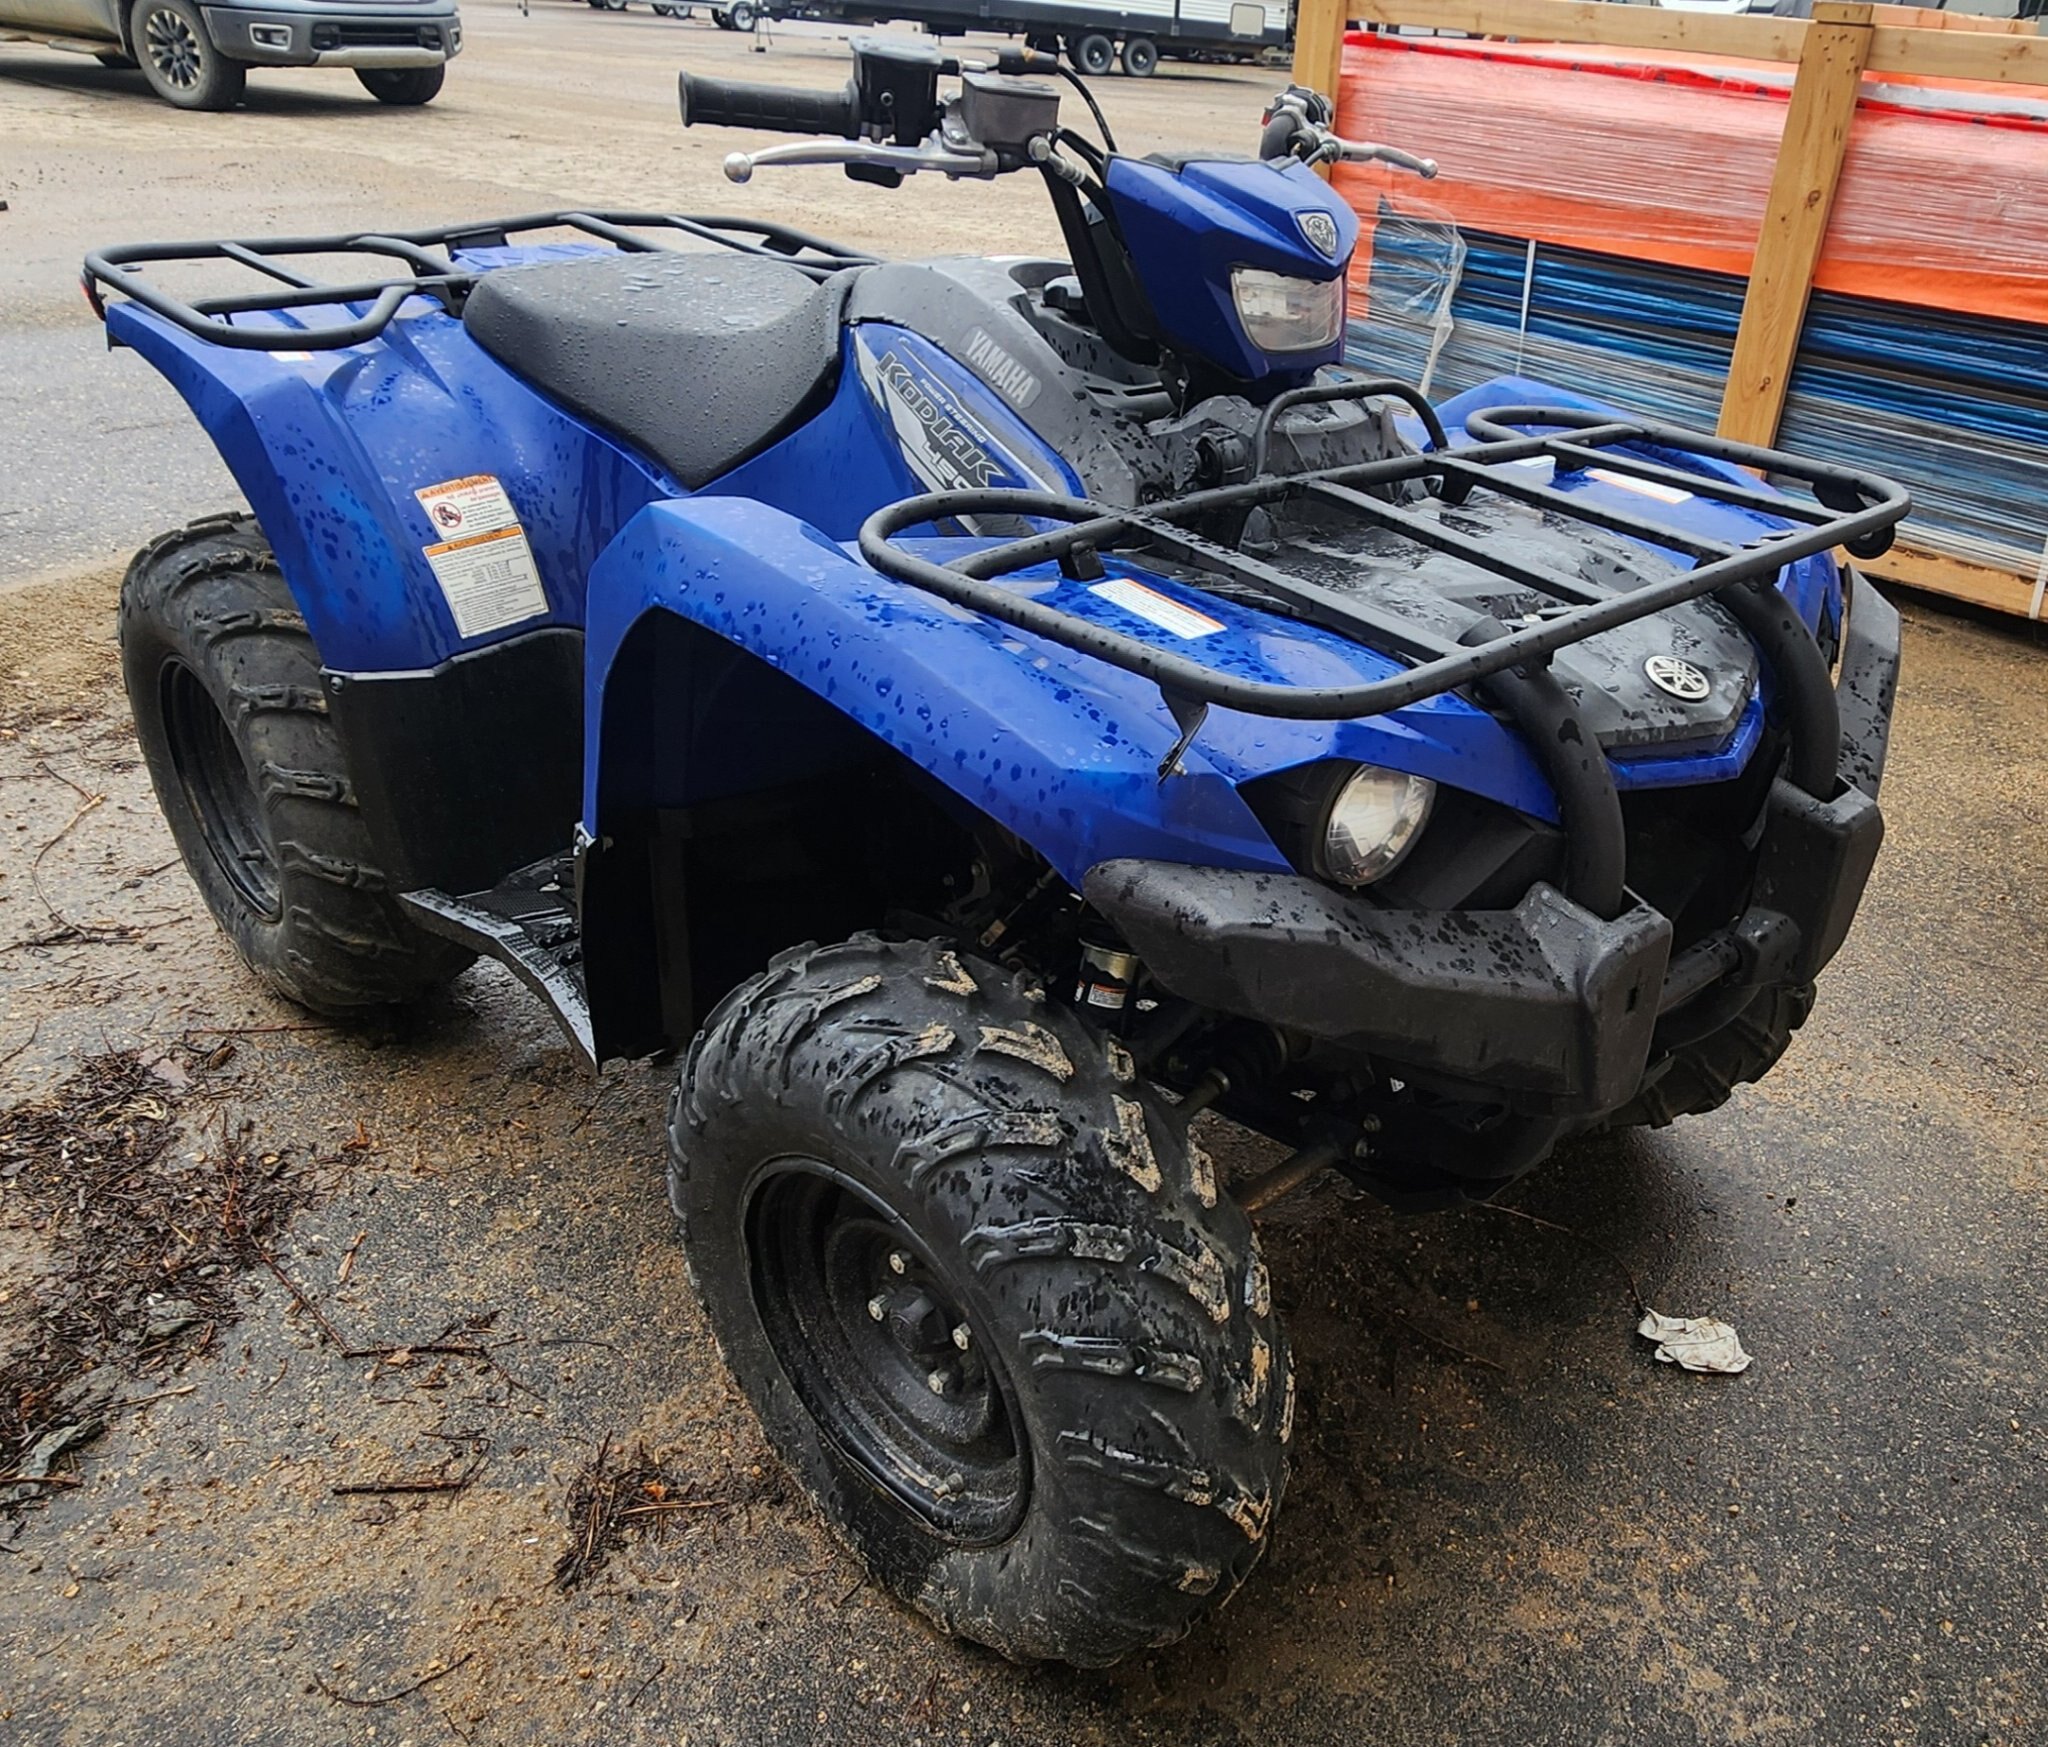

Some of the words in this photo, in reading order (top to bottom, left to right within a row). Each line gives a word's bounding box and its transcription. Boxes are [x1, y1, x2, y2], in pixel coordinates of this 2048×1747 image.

[966, 330, 1034, 404] YAMAHA
[876, 351, 1007, 487] KODIAK
[920, 378, 946, 404] POWER
[944, 403, 987, 443] STEERING
